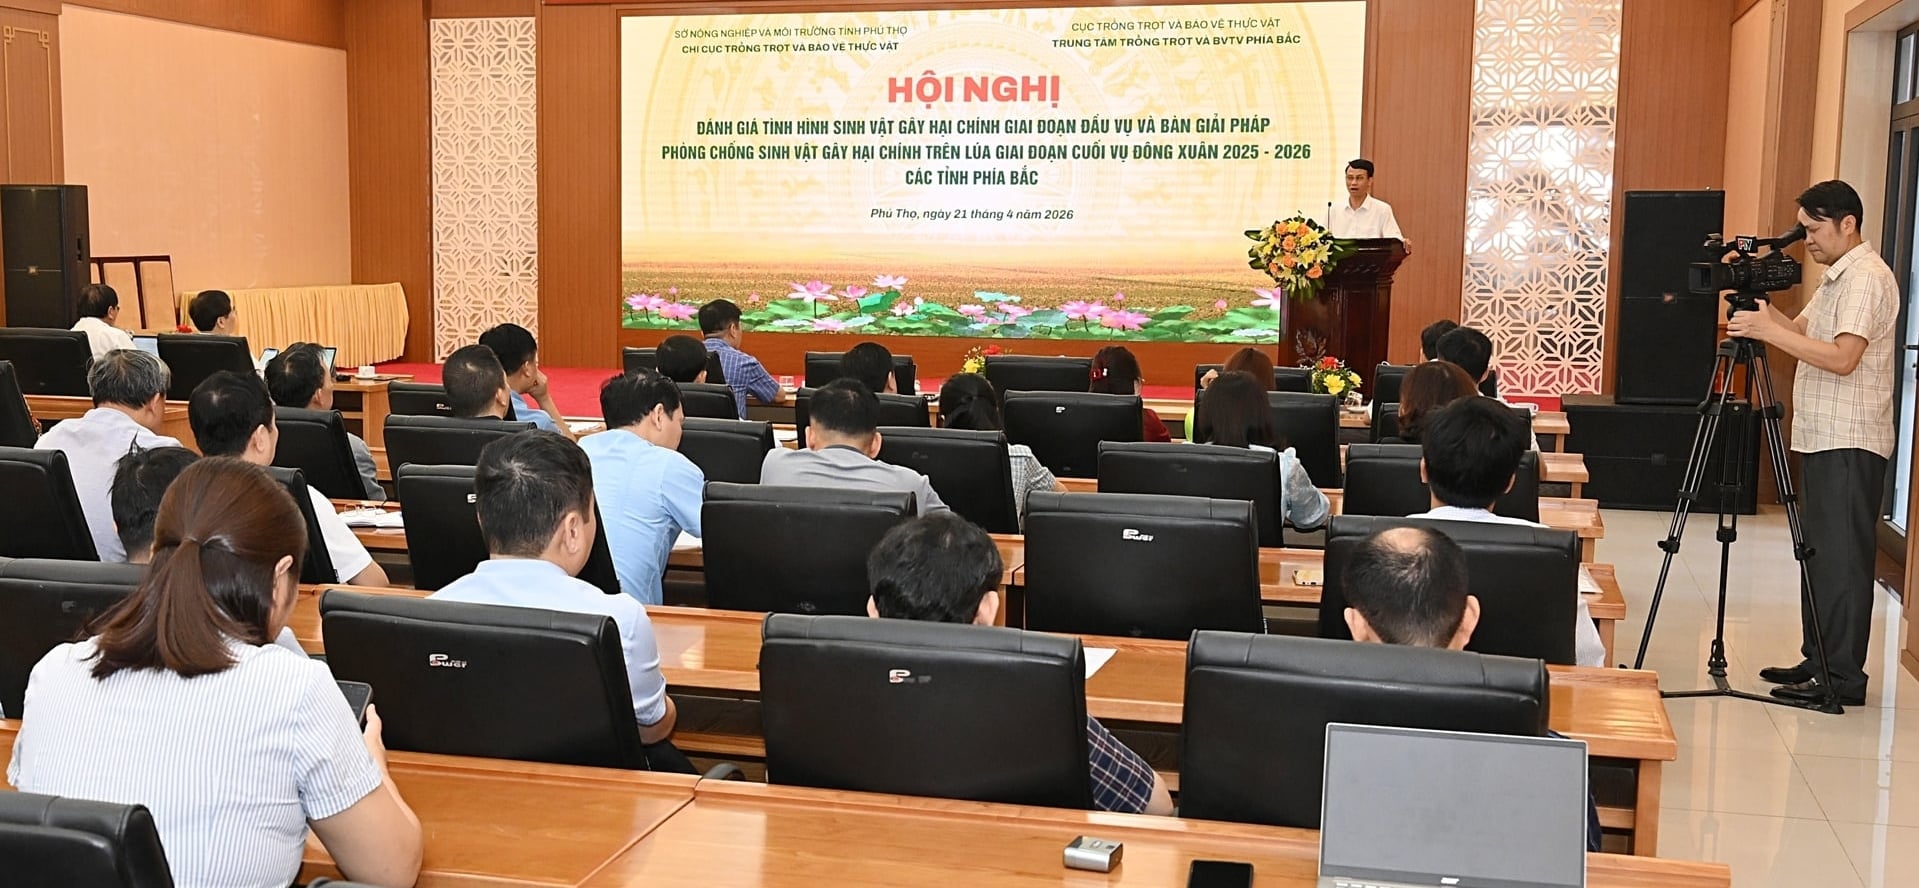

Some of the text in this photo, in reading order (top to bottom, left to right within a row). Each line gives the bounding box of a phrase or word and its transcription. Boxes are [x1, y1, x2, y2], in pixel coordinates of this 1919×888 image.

[1052, 39, 1091, 48] TRUNG
[1213, 36, 1243, 45] BVTV
[889, 70, 1060, 109] HỘI NGHỊ
[697, 118, 732, 135] ĐÁNH
[737, 118, 758, 135] GIÁ
[763, 118, 792, 135] TÌNH
[797, 117, 828, 135] HÌNH
[834, 120, 865, 135] SINH
[870, 117, 894, 138] VẬT
[899, 117, 925, 134] GÂY
[930, 120, 952, 137] HẠI
[957, 116, 999, 134] CHÍNH
[1005, 119, 1032, 134] GIAI
[1037, 119, 1076, 137] ĐOẠN
[1081, 114, 1109, 133] ĐẦU
[1115, 119, 1133, 136] VỤ
[1137, 115, 1155, 133] VÀ
[1196, 113, 1225, 133] GIẢI
[1230, 115, 1270, 133] PHÁP
[662, 142, 705, 160] PHÒNG
[710, 140, 754, 160] CHỐNG
[759, 145, 789, 160] SINH
[794, 142, 818, 163] VẬT
[823, 142, 848, 159] GÂY
[853, 145, 874, 163] HẠI
[880, 142, 921, 159] CHÍNH
[926, 142, 960, 159] TRÊN
[966, 142, 991, 159] LÚA
[996, 145, 1023, 159] GIAI
[1028, 145, 1067, 163] ĐOẠN
[1072, 140, 1105, 159] CUỐI
[1110, 145, 1128, 163] VỤ
[1133, 142, 1173, 159] ĐÔNG
[1178, 141, 1218, 159] XUÂN
[1223, 145, 1258, 159] 2025
[1275, 145, 1310, 159] 2026
[906, 165, 1038, 185] CÁC TỈNH PHÍA BẮC
[871, 209, 1074, 221] Phú Thọ, ngày 21 tháng 4 năm 2026
